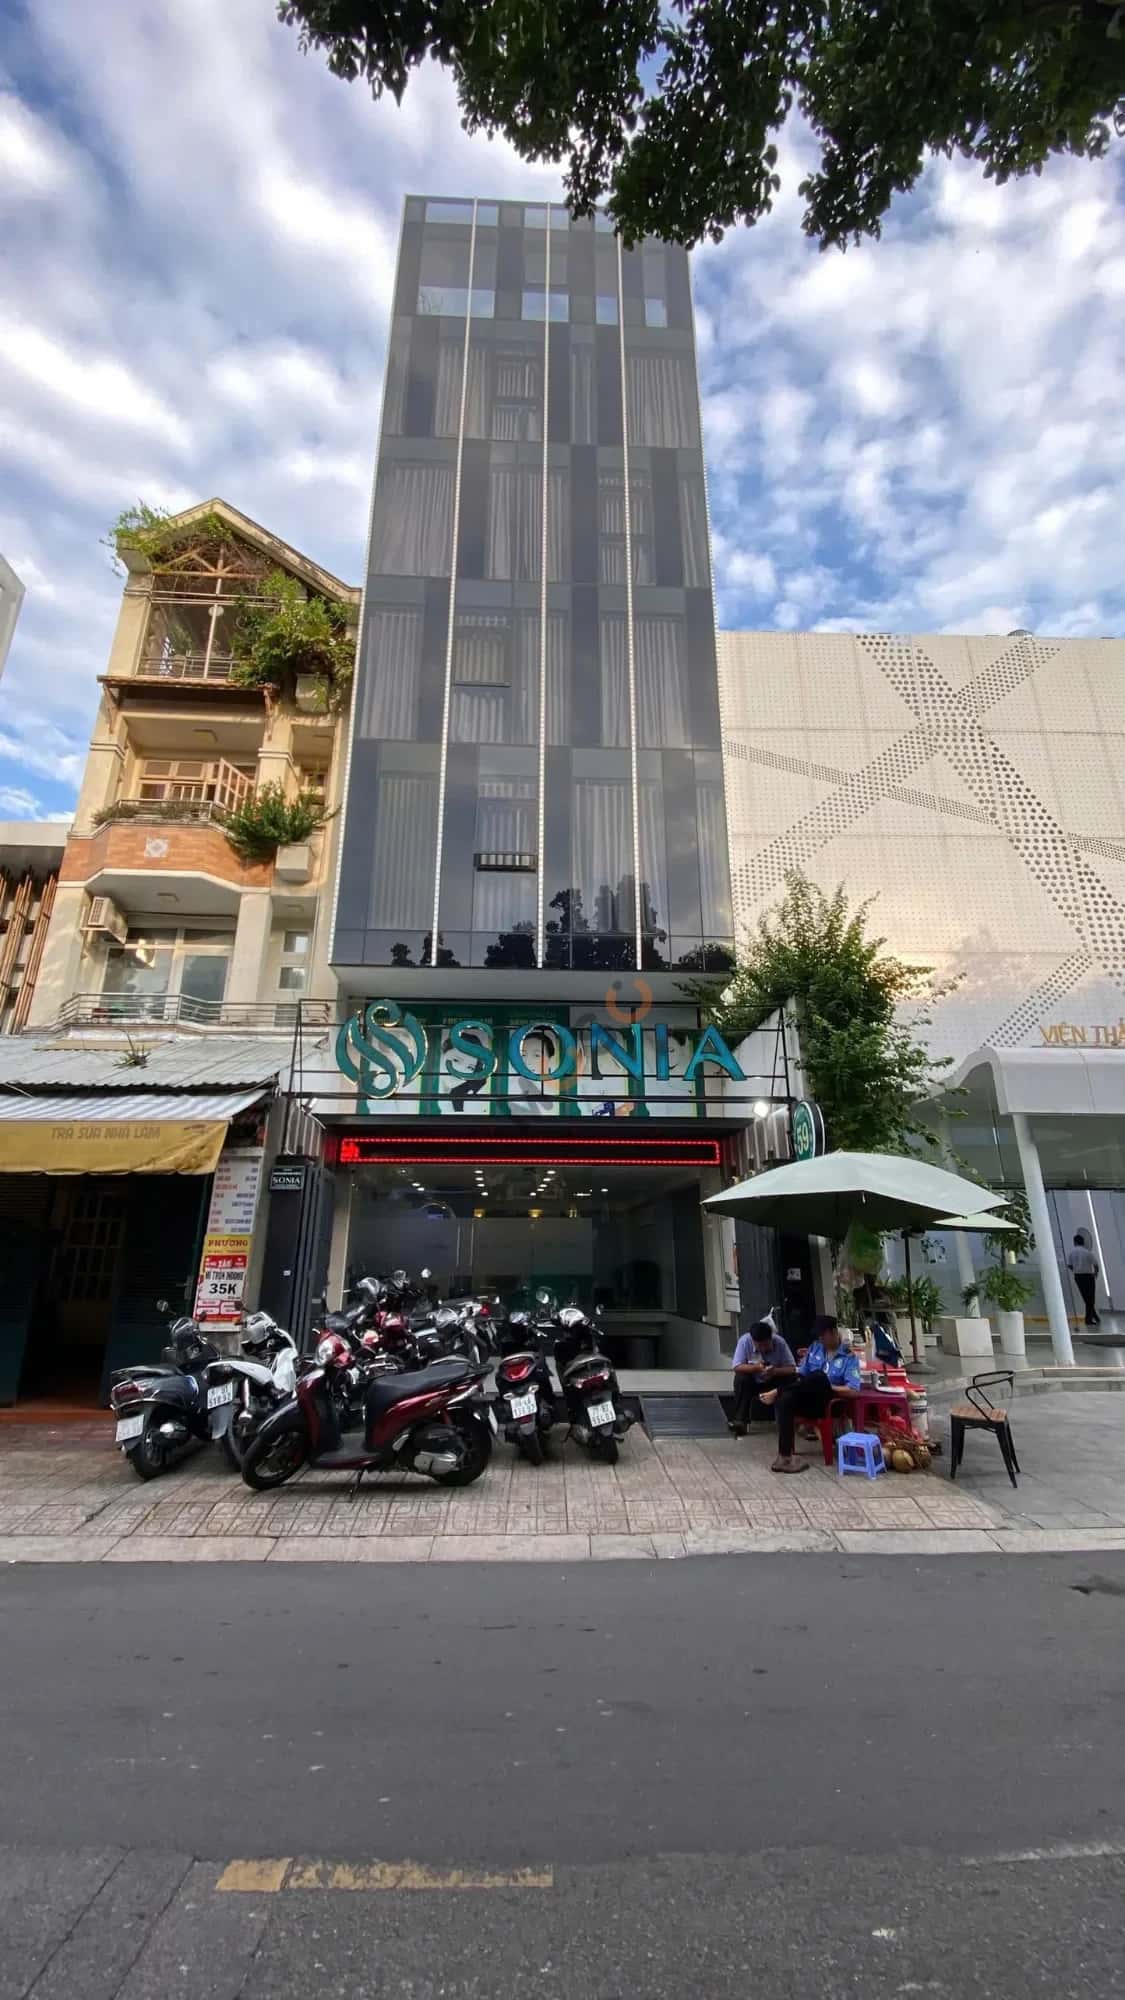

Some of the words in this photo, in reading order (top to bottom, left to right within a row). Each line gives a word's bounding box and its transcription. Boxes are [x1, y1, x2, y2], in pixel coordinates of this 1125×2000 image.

[445, 1020, 747, 1081] SONIA
[796, 1121, 809, 1155] 59
[272, 1176, 301, 1185] SONIA
[209, 1283, 237, 1295] 35K
